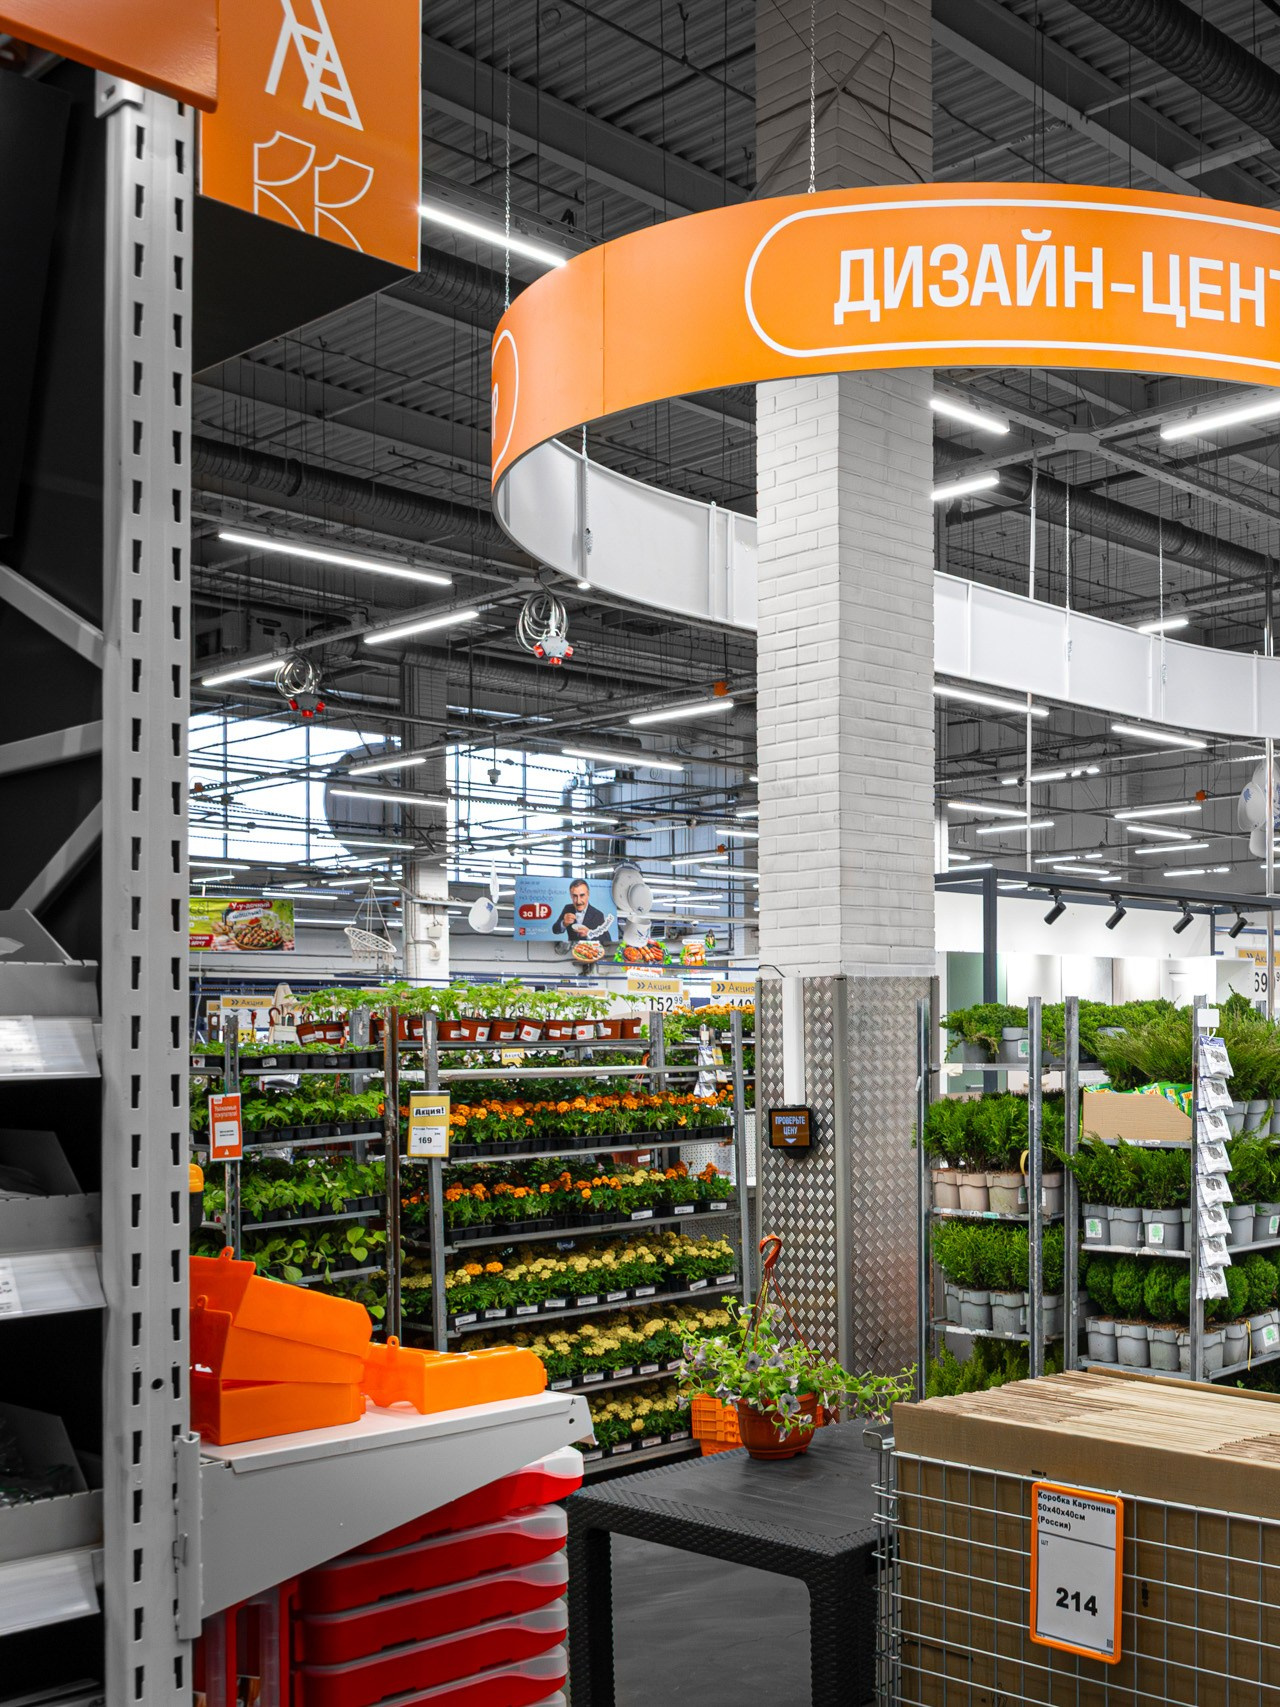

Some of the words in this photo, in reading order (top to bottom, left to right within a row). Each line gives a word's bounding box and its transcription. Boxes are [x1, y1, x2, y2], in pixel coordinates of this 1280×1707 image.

[648, 982, 671, 992] Акция
[415, 1107, 445, 1116] Акция!
[775, 1116, 805, 1125] ПРОВЕРЬТЕ
[783, 1126, 798, 1136] ЦЕНУ
[1037, 1490, 1071, 1506] Коробка
[1072, 1500, 1116, 1515] Картонная
[1037, 1516, 1072, 1531] (Россия)
[1055, 1587, 1098, 1617] 214
